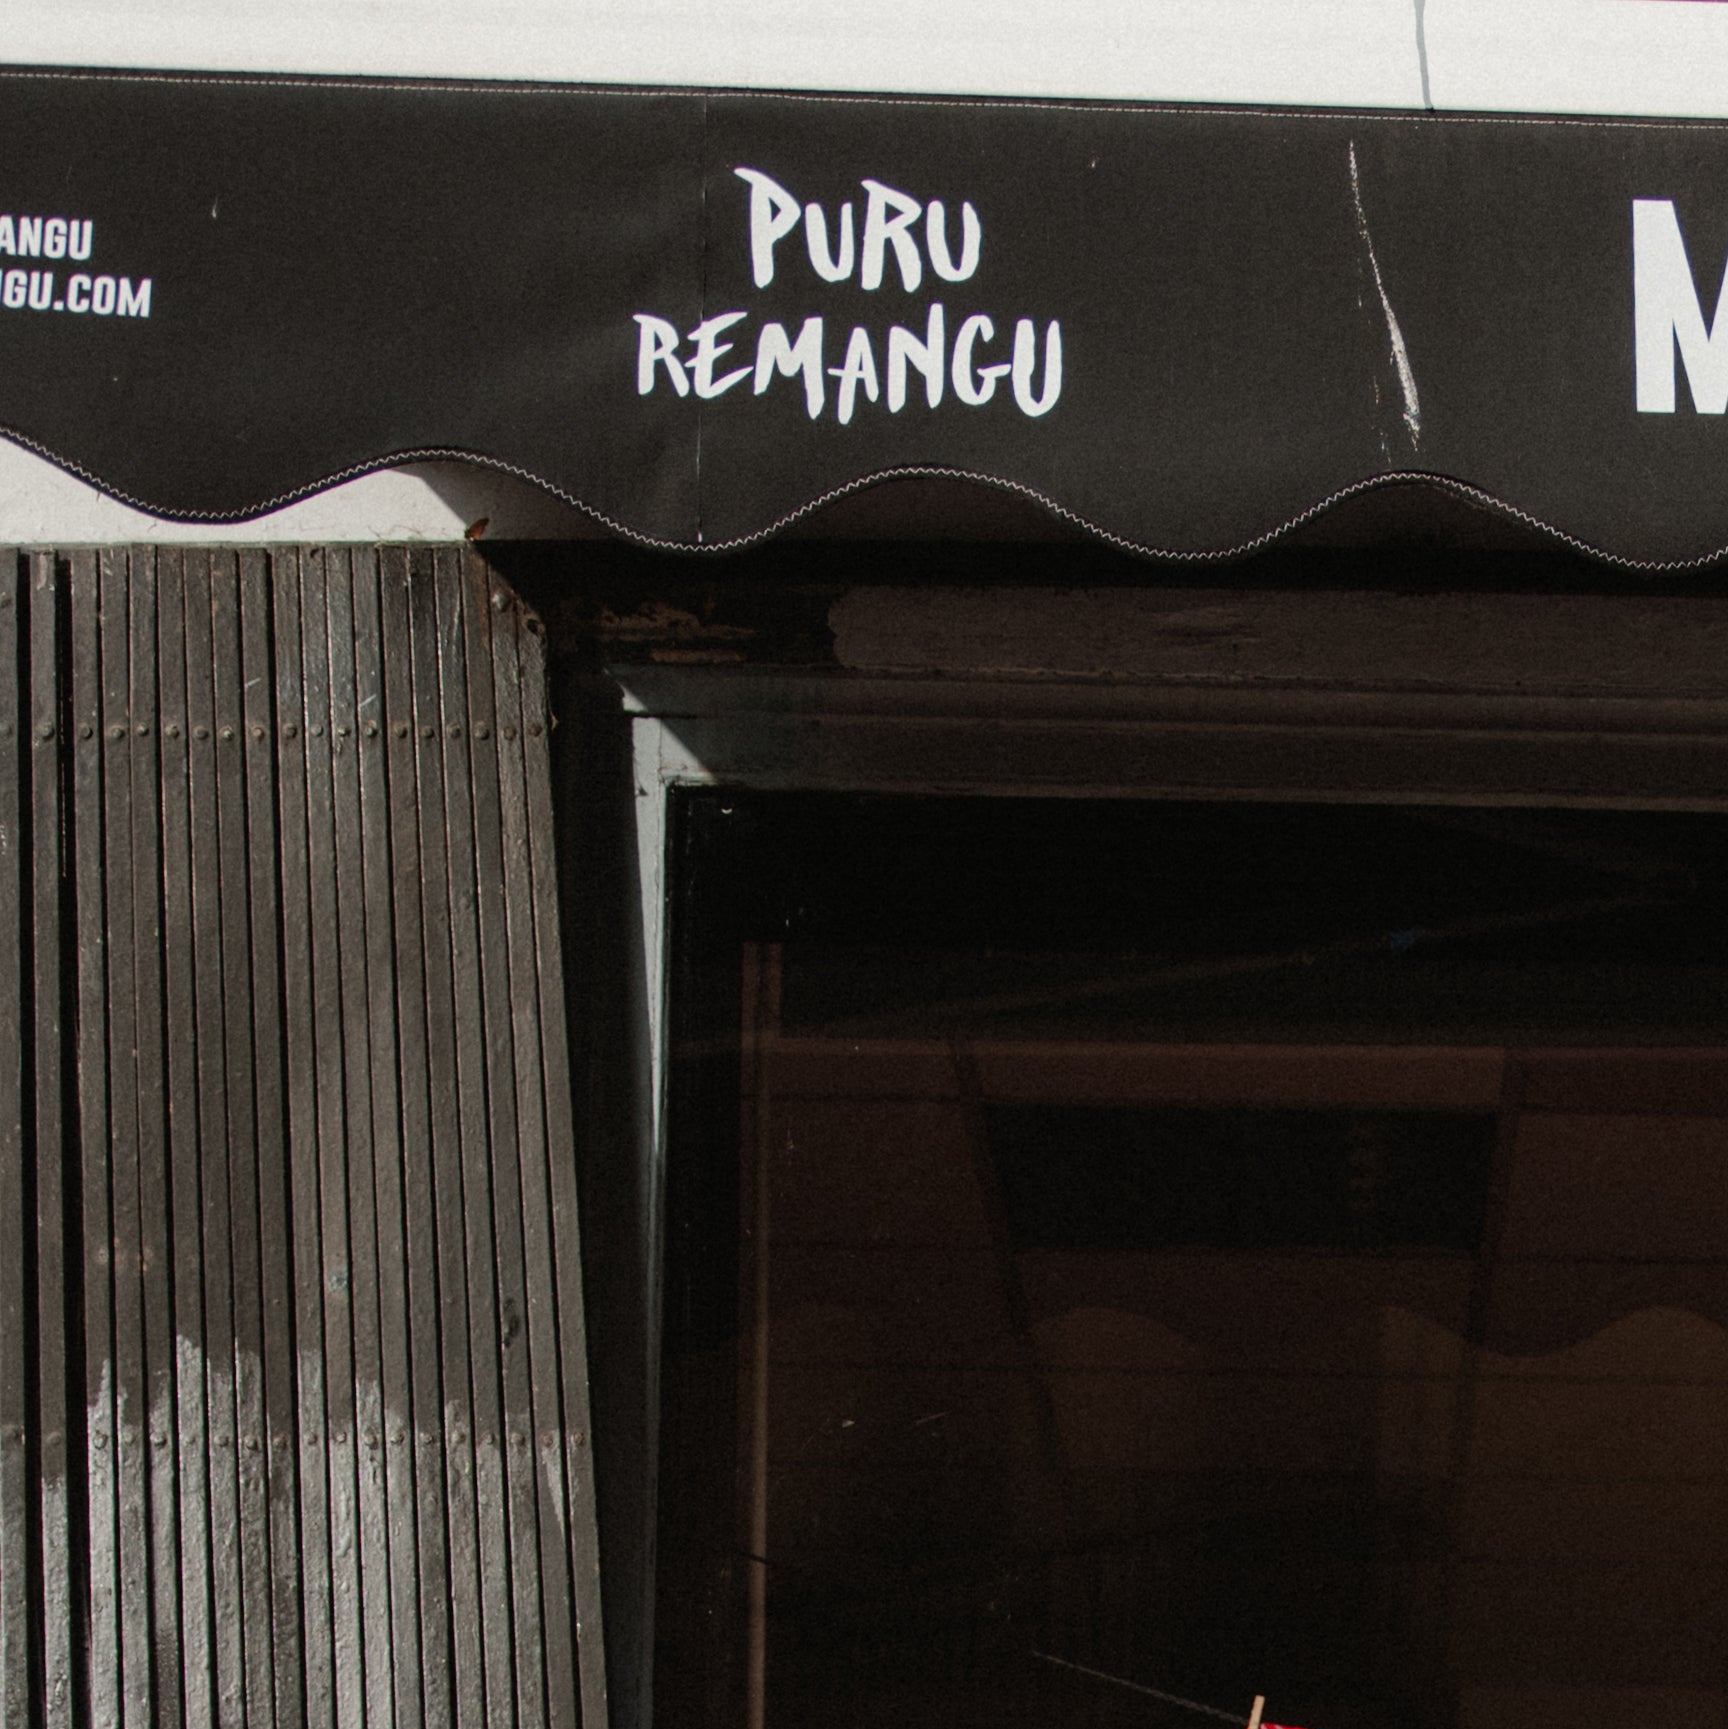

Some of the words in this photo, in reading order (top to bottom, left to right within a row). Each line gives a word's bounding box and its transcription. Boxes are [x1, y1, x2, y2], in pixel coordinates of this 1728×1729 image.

[734, 167, 982, 293] PURU
[0, 268, 152, 318] GU.COM
[632, 303, 1063, 425] REMANGU
